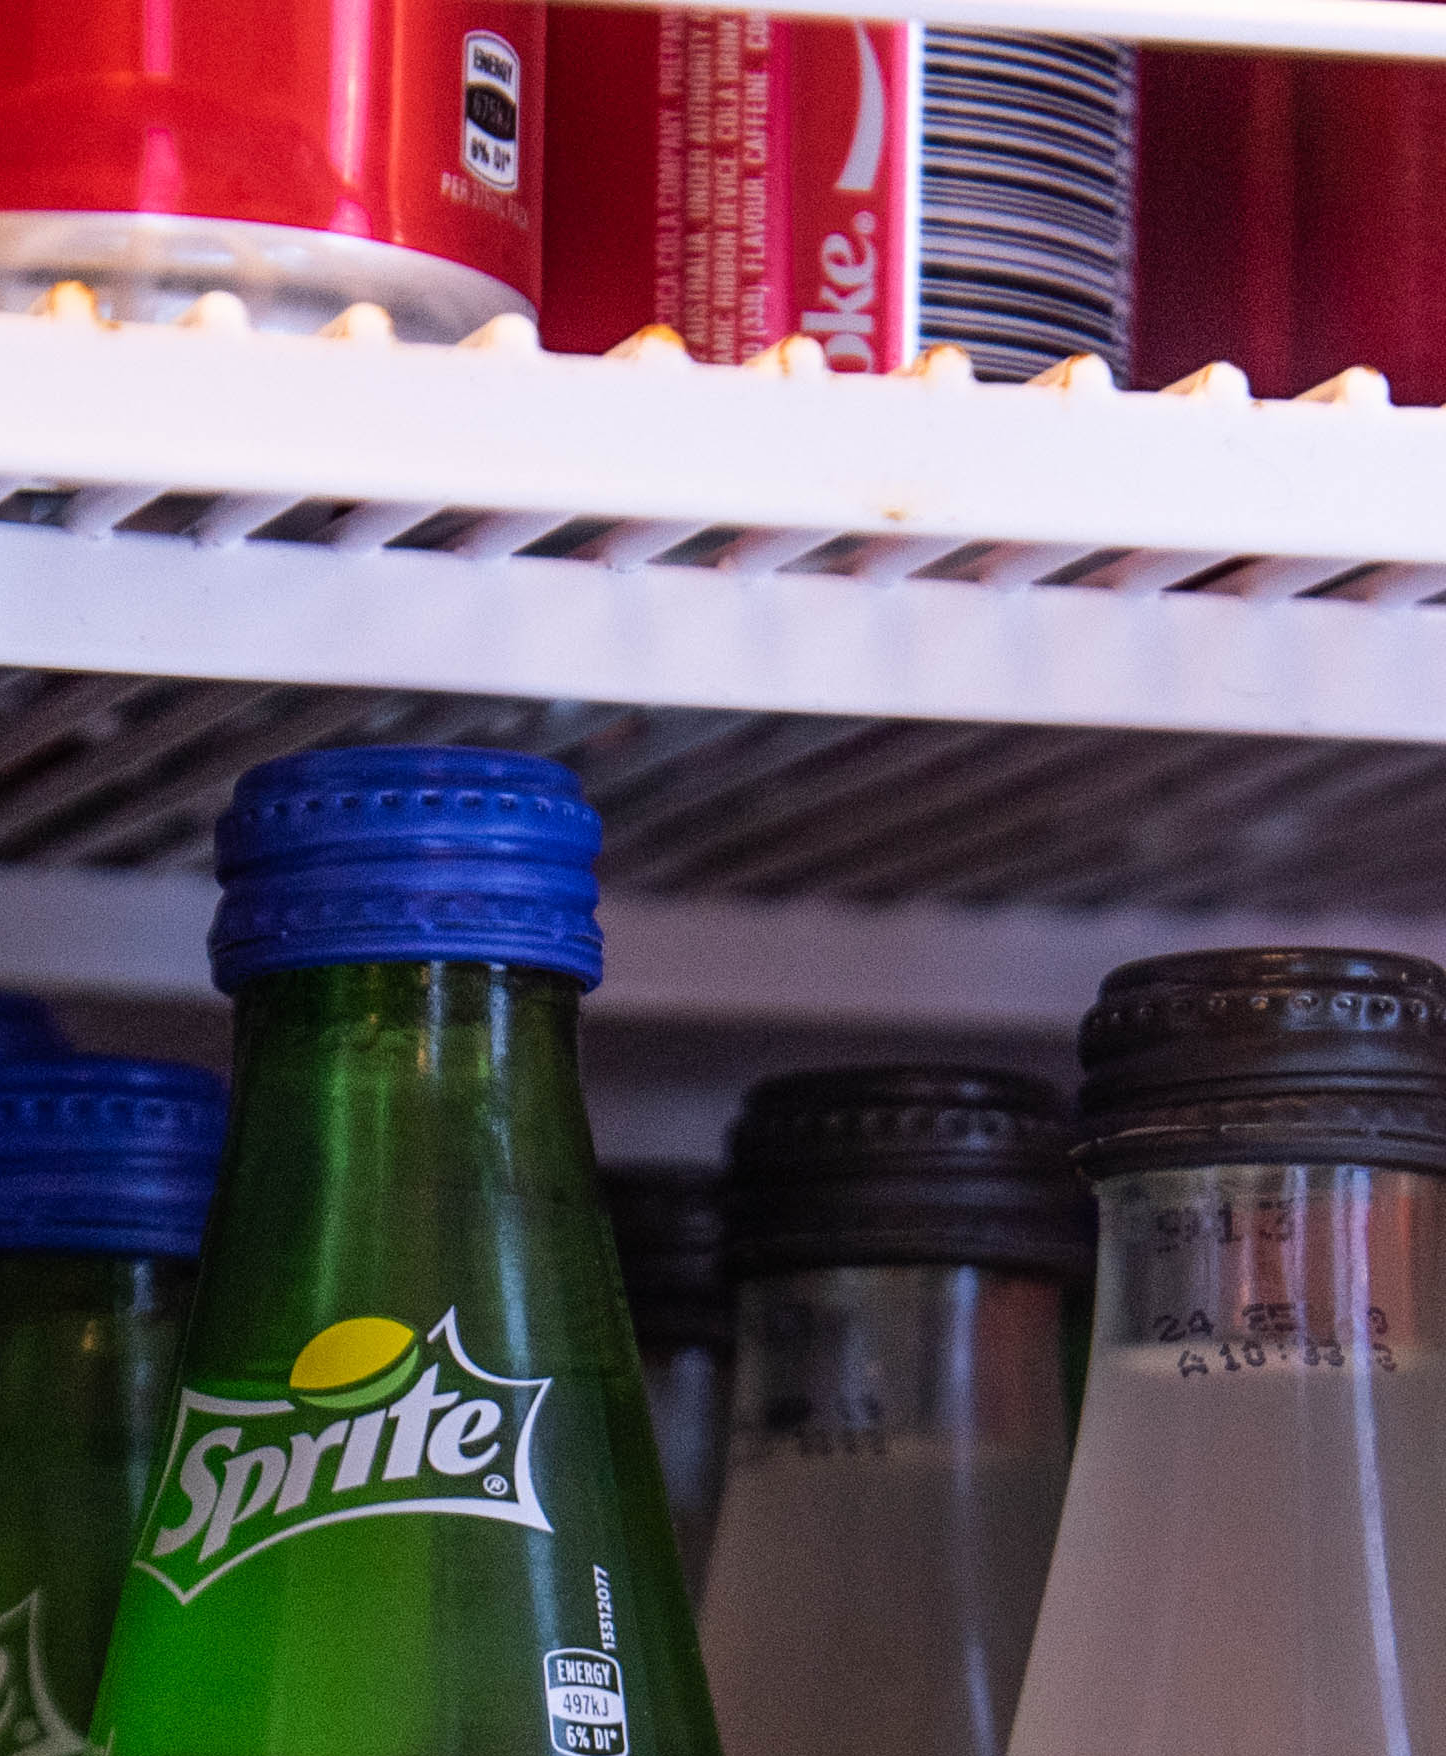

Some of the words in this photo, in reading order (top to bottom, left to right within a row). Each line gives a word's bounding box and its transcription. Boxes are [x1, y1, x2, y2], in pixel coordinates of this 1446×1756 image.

[151, 1362, 502, 1565] Sprite
[593, 1564, 617, 1652] 13312077
[556, 1658, 611, 1688] ENERGY
[562, 1692, 610, 1718] 497kJ
[565, 1724, 590, 1749] 6%
